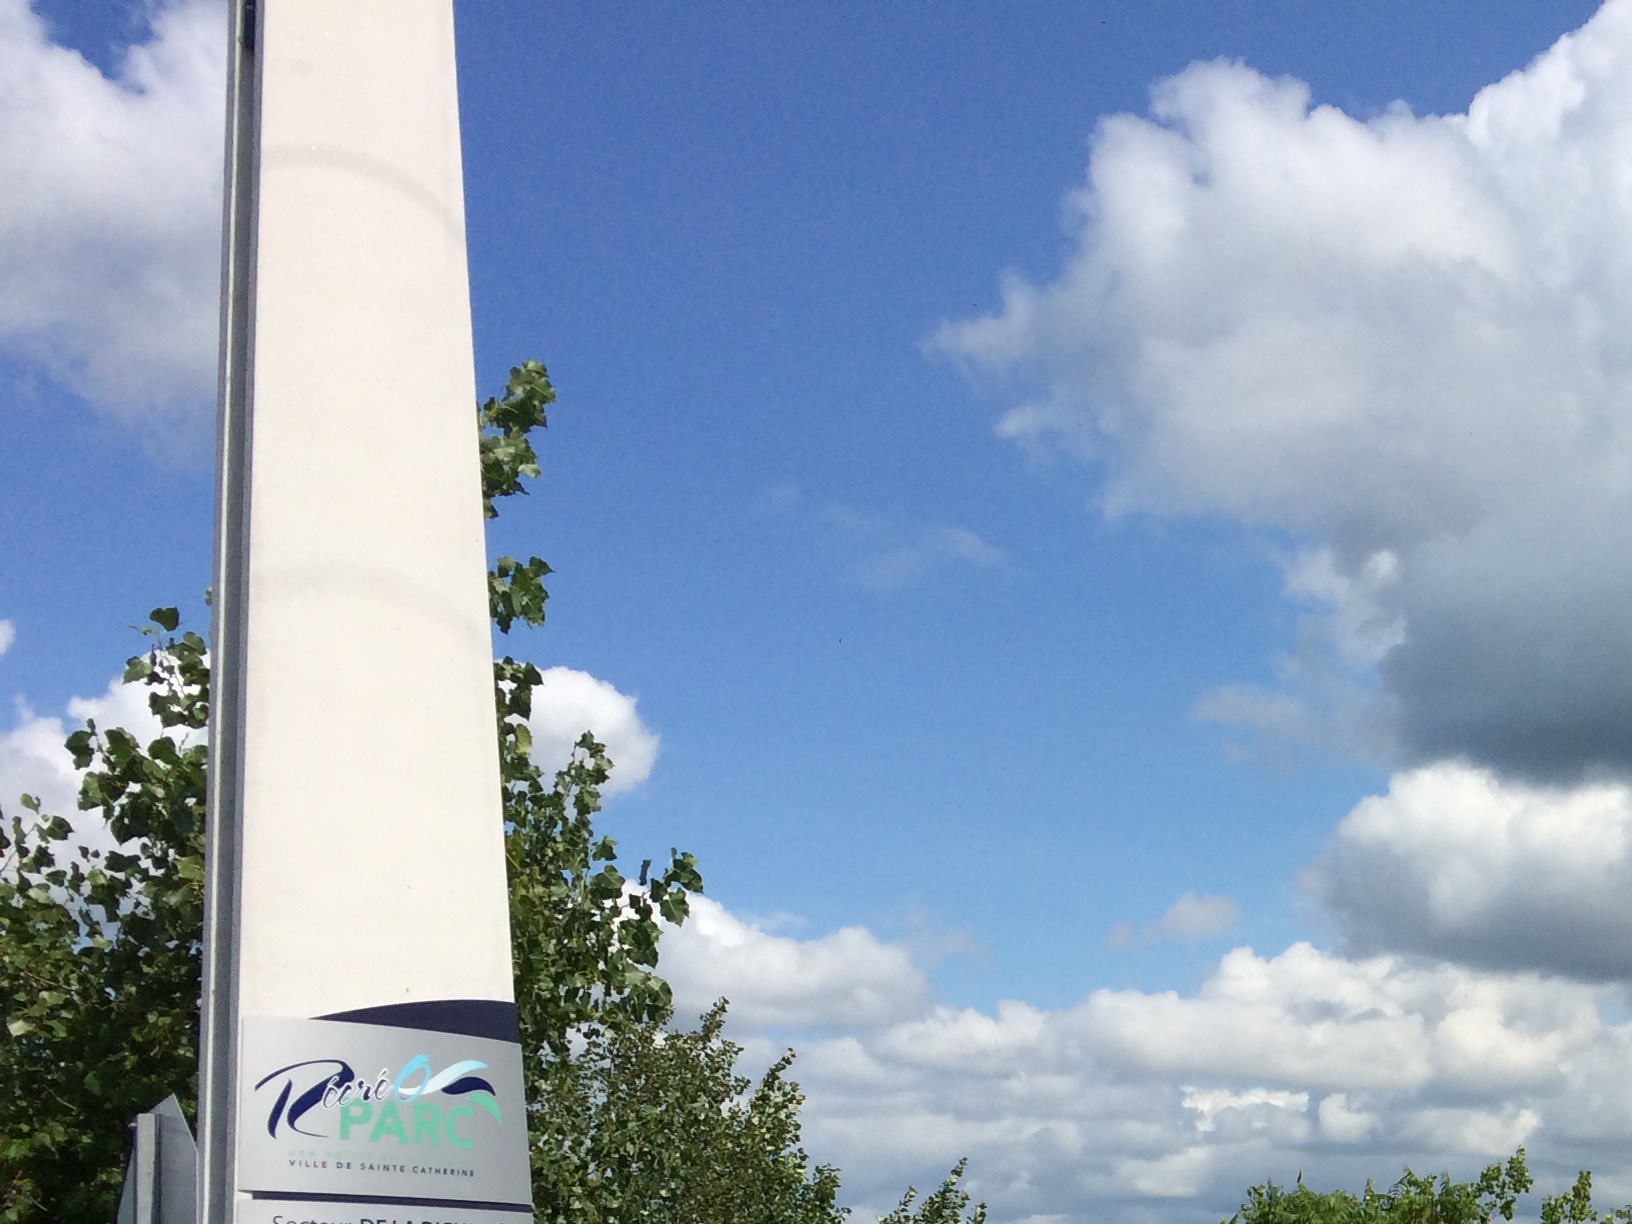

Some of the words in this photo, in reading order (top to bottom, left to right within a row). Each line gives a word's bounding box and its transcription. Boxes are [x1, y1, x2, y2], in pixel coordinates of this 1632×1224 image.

[339, 1098, 475, 1150] PARC
[289, 1160, 328, 1169] VILLE
[336, 1161, 352, 1170] DE
